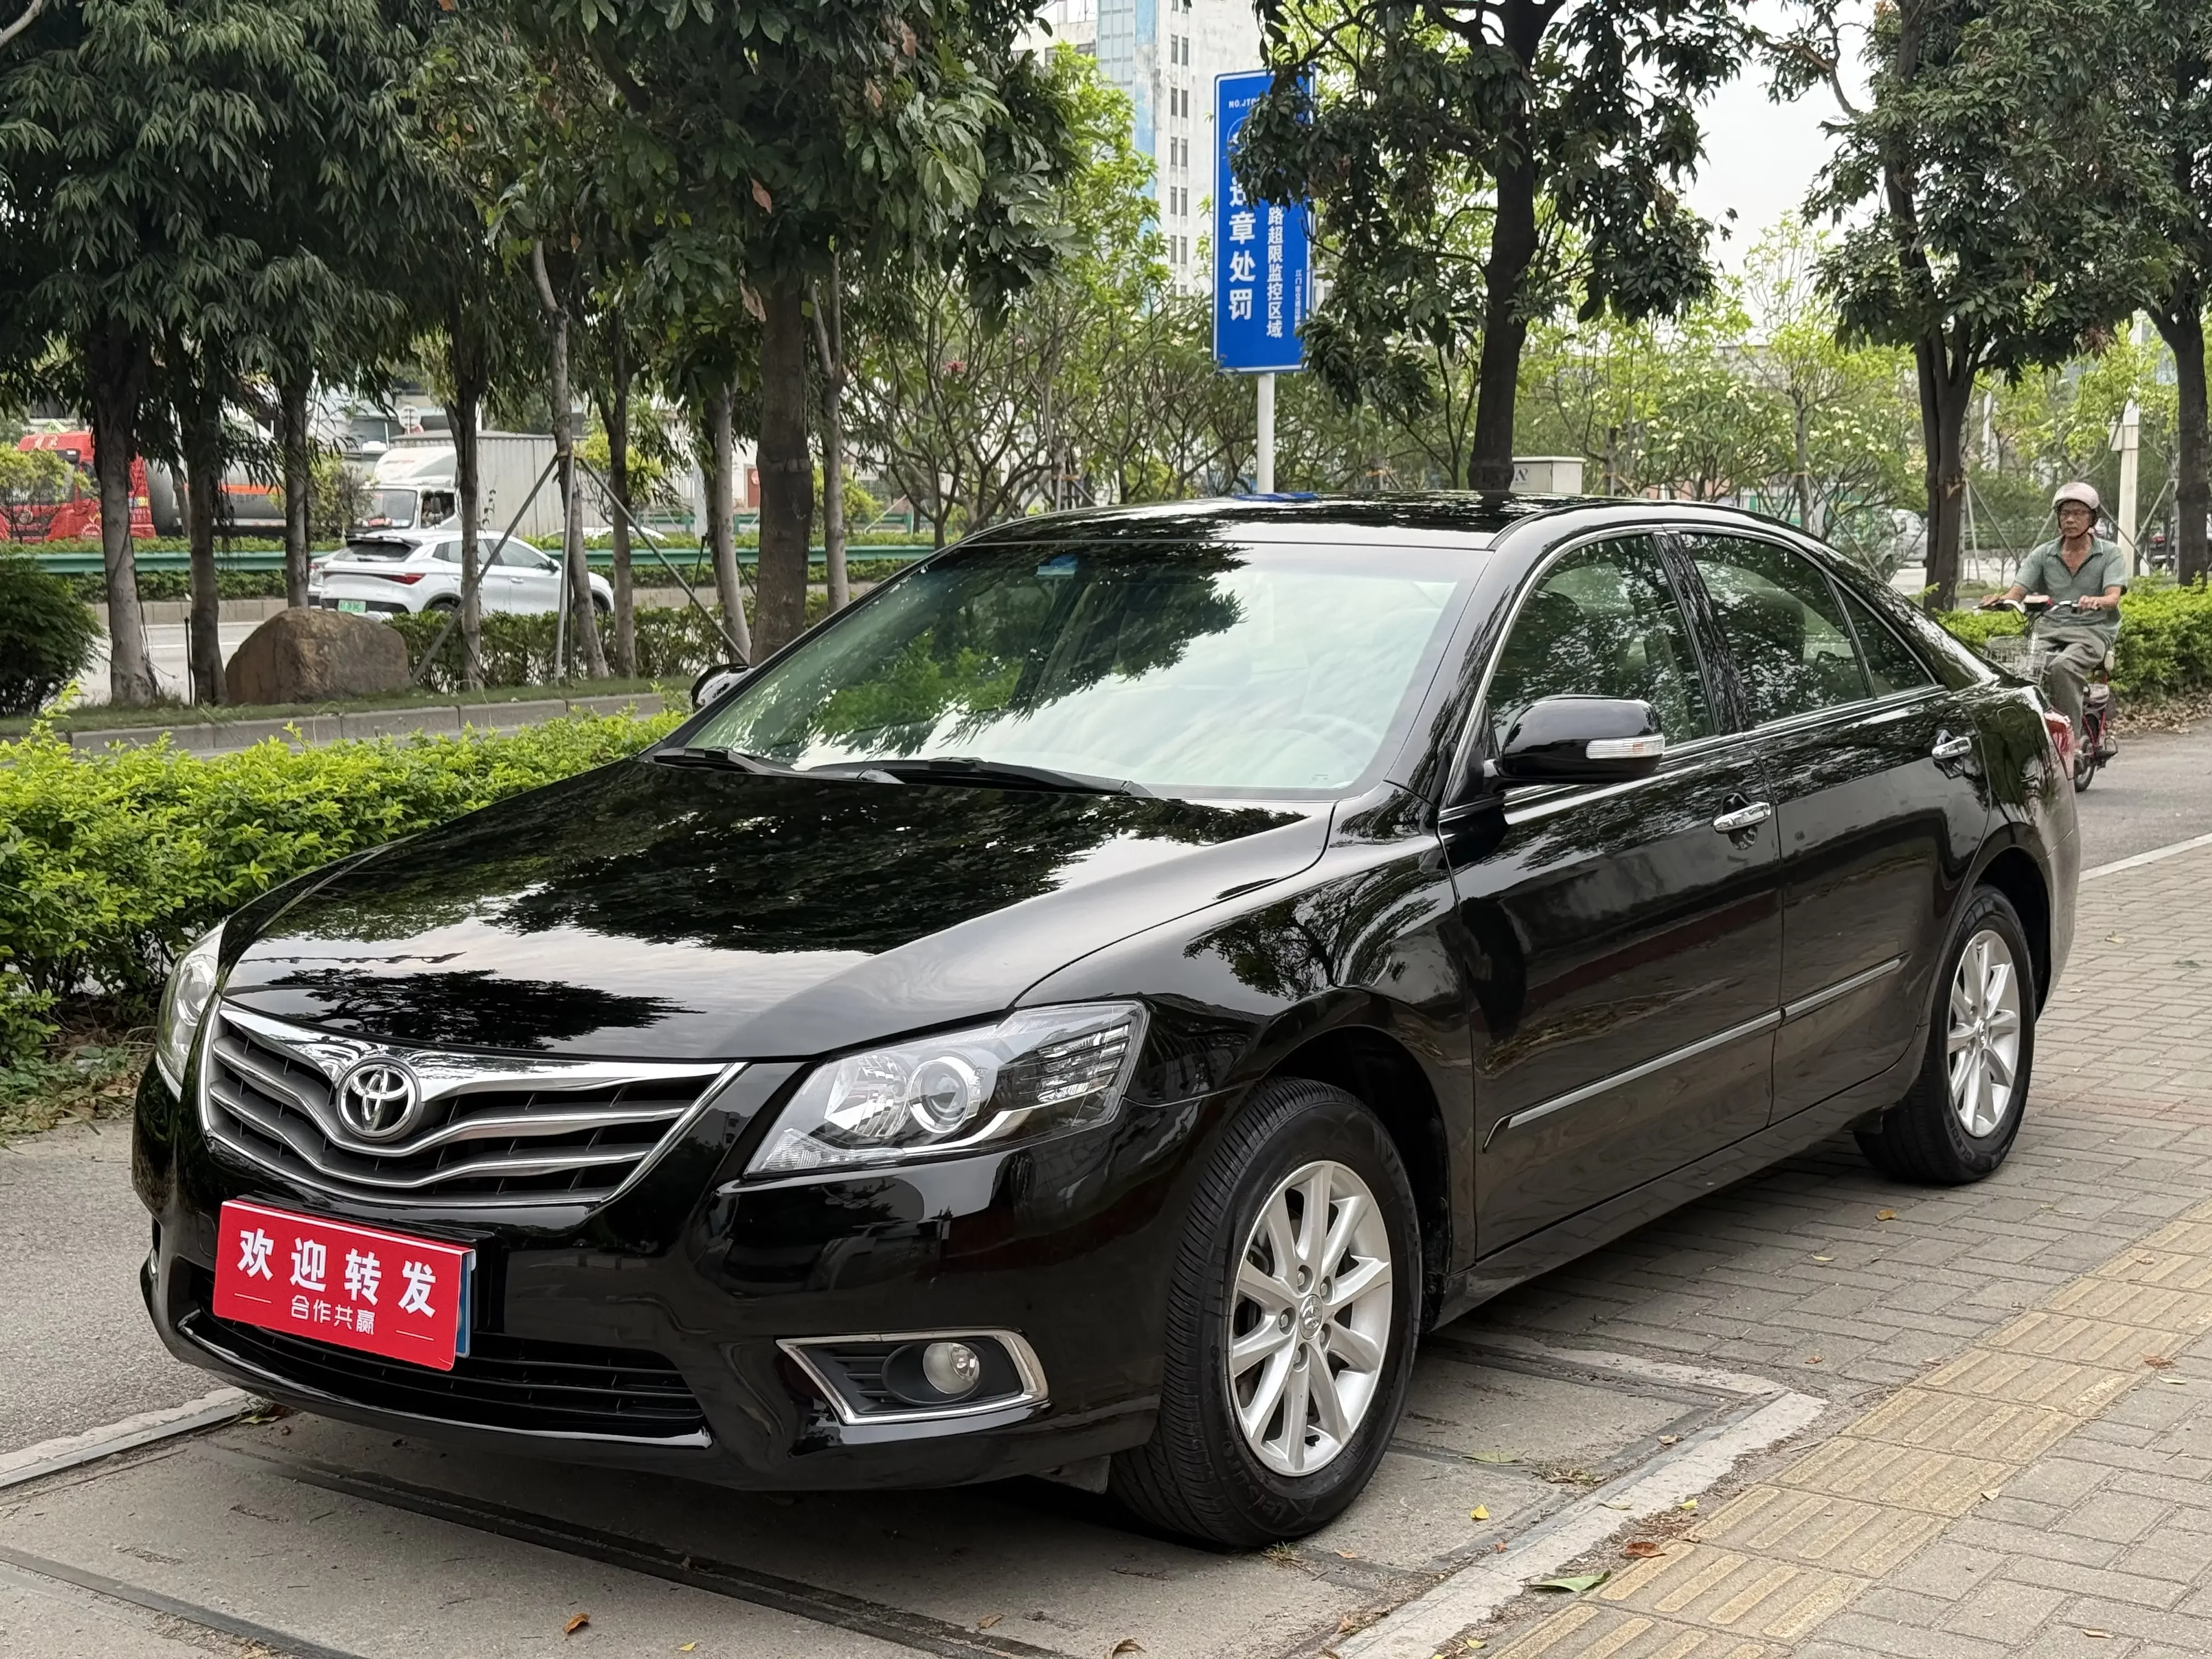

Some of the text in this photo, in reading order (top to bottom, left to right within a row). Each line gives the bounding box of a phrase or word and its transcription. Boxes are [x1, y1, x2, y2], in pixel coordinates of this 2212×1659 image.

[1228, 97, 1261, 109] NO.JT
[1266, 199, 1284, 338] 路超限监控区域
[237, 1227, 437, 1318] 欢迎转发
[291, 1295, 376, 1335] 合作共赢
